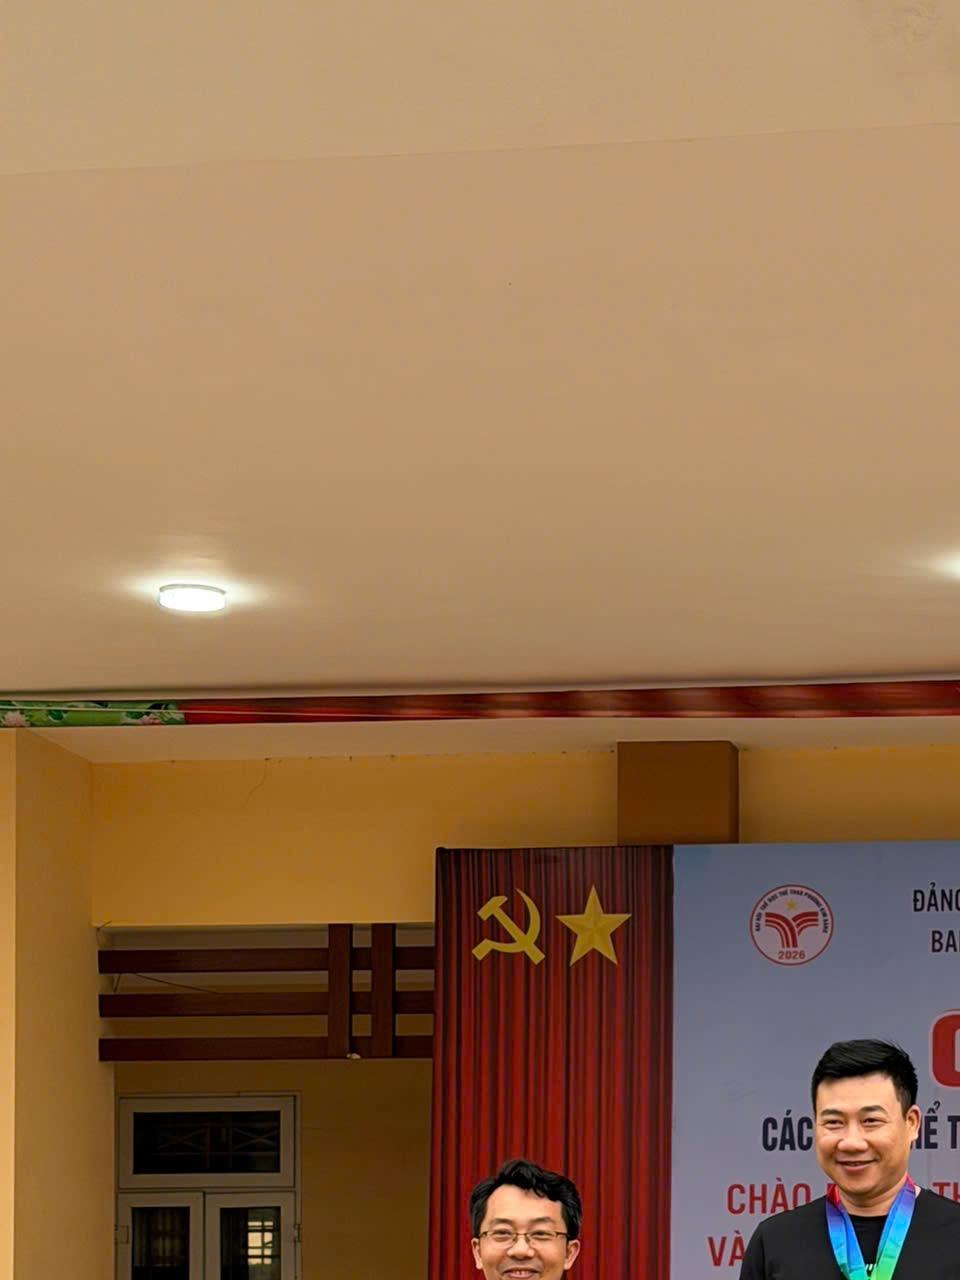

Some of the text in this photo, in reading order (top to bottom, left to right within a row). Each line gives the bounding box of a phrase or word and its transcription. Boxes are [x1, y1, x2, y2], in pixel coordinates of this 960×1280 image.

[778, 950, 806, 960] 2026
[762, 1109, 813, 1151] CÁC
[727, 1177, 811, 1214] CHÀO
[707, 1230, 745, 1267] VÀ
